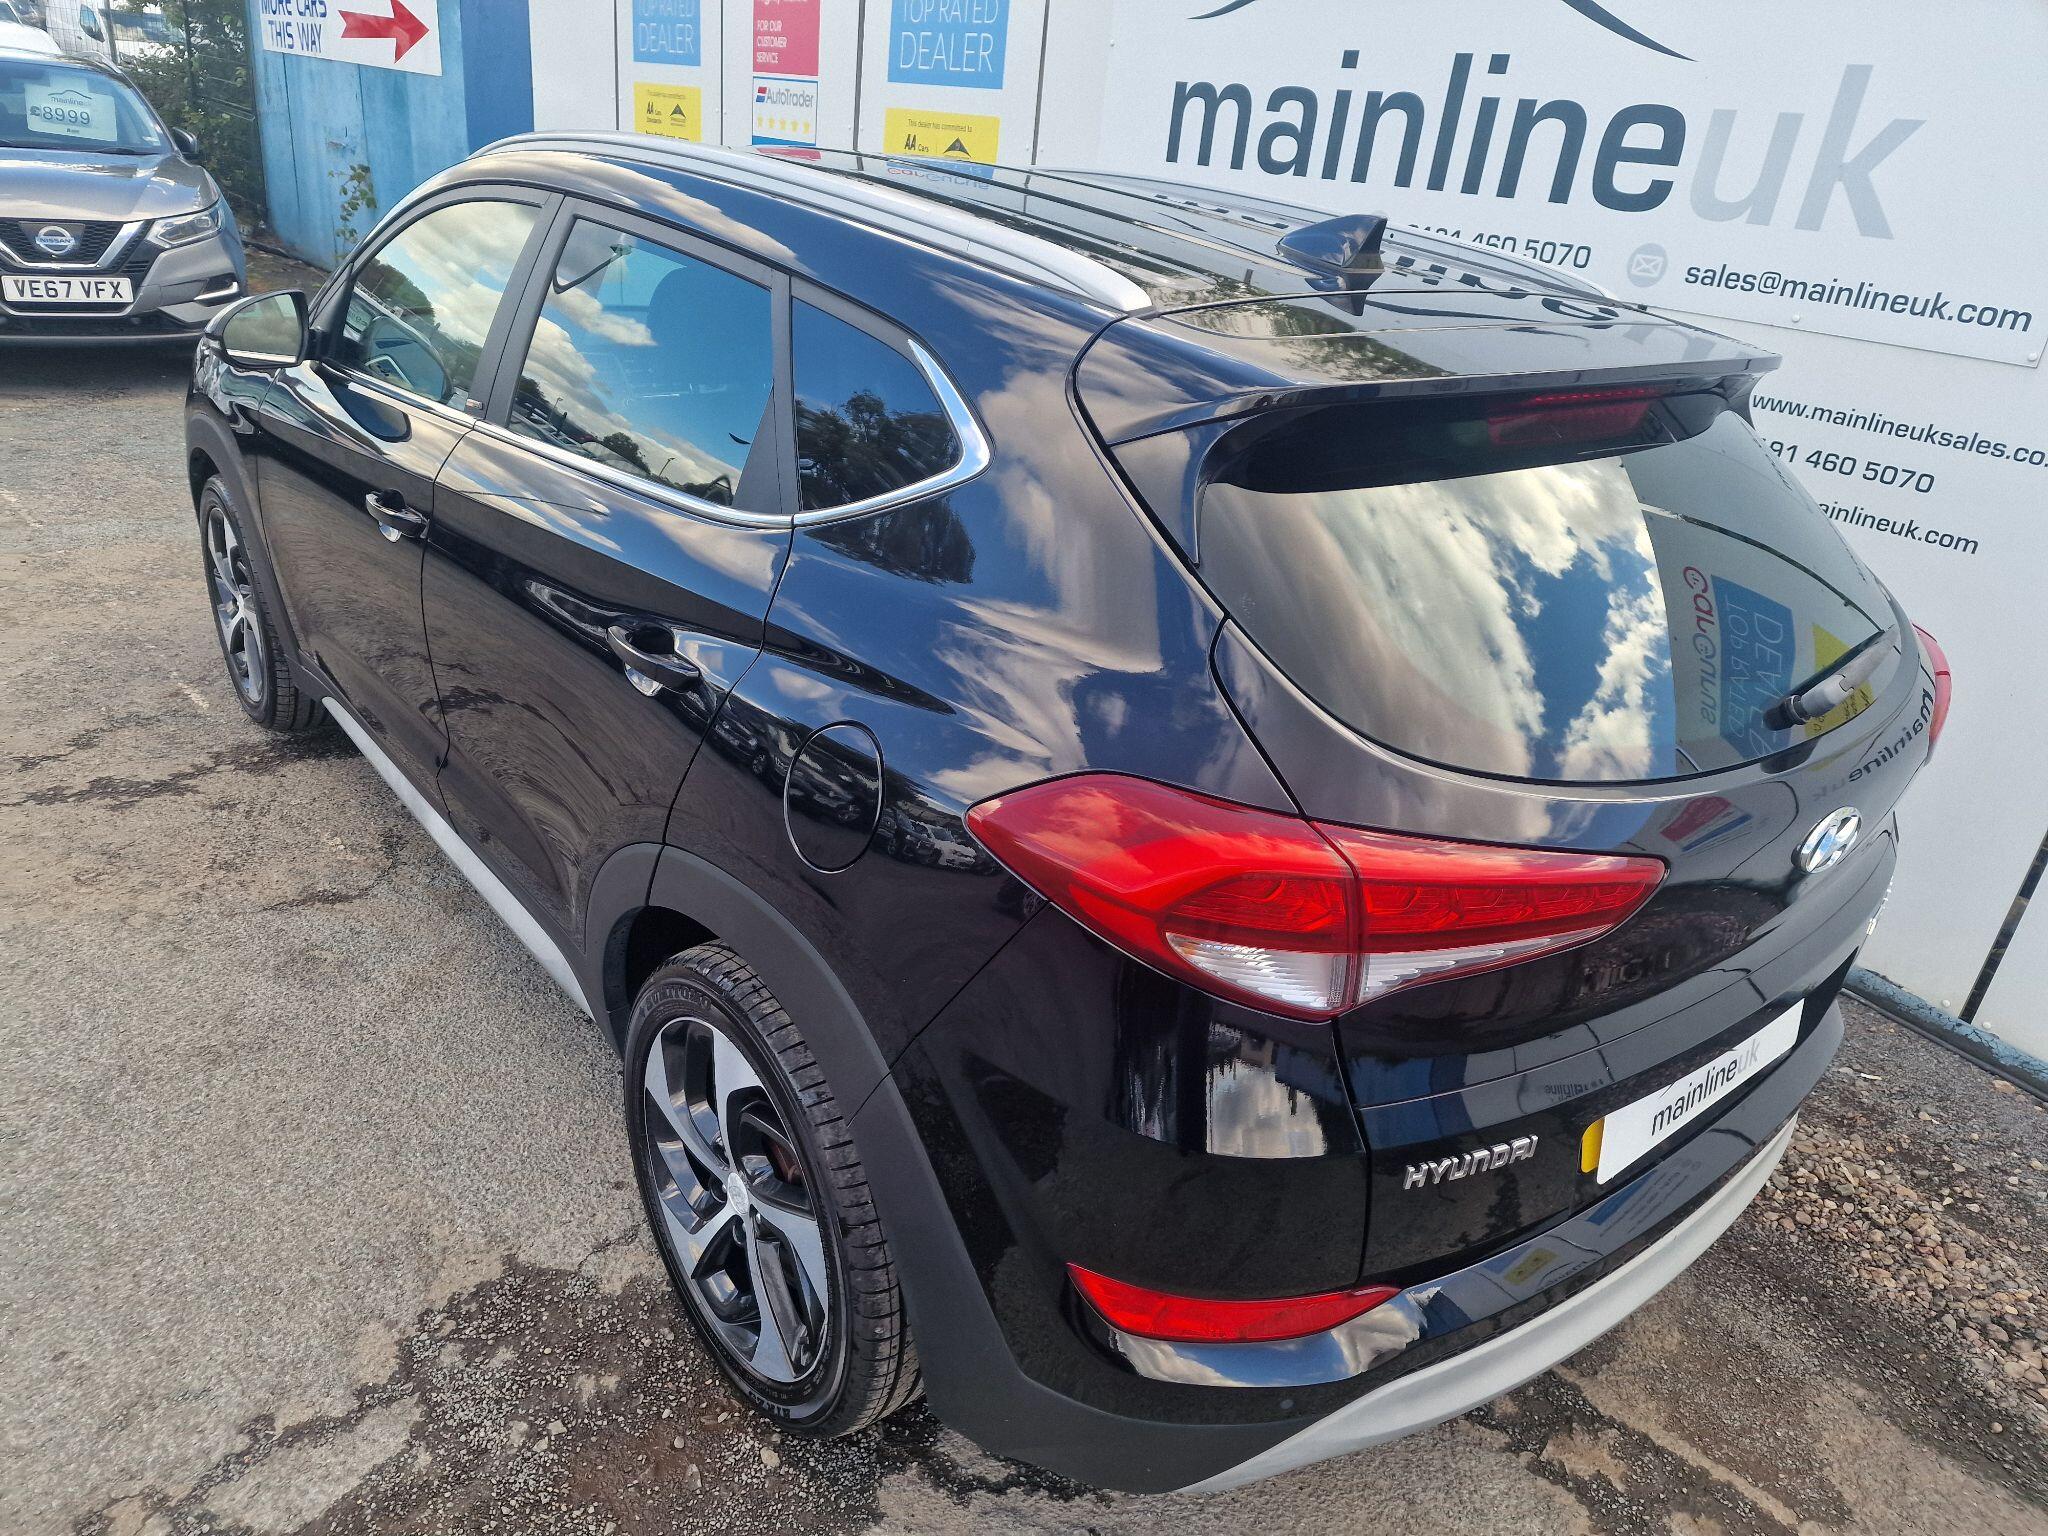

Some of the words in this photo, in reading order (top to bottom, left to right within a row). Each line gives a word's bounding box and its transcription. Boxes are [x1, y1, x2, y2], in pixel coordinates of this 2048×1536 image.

[297, 0, 326, 18] CARS
[903, 0, 935, 23] TOP
[939, 0, 999, 24] RATED
[268, 20, 295, 50] THIS
[296, 21, 322, 53] WAY
[757, 19, 769, 32] FOR
[769, 19, 783, 32] OUR
[639, 22, 695, 55] DEALER
[757, 35, 788, 48] CUSTOMER
[756, 51, 780, 64] SERVICE
[900, 31, 993, 73] DEALER
[766, 87, 814, 108] AutoTrader
[29, 105, 91, 126] £8999
[908, 118, 917, 127] This
[904, 133, 917, 151] AA
[917, 143, 929, 153] Cars
[1166, 50, 1928, 240] mainlineuk
[41, 237, 71, 245] NISSAN
[1523, 237, 1593, 269] 5070
[12, 279, 72, 299] VE67
[80, 281, 124, 299] VFX
[1684, 263, 2034, 332] sales@mainlineuk.com
[1805, 450, 1857, 476] 460
[1862, 460, 1936, 494] 5070
[1651, 1038, 1760, 1136] mainlineuk
[1402, 1133, 1539, 1190] HYUNDAI
